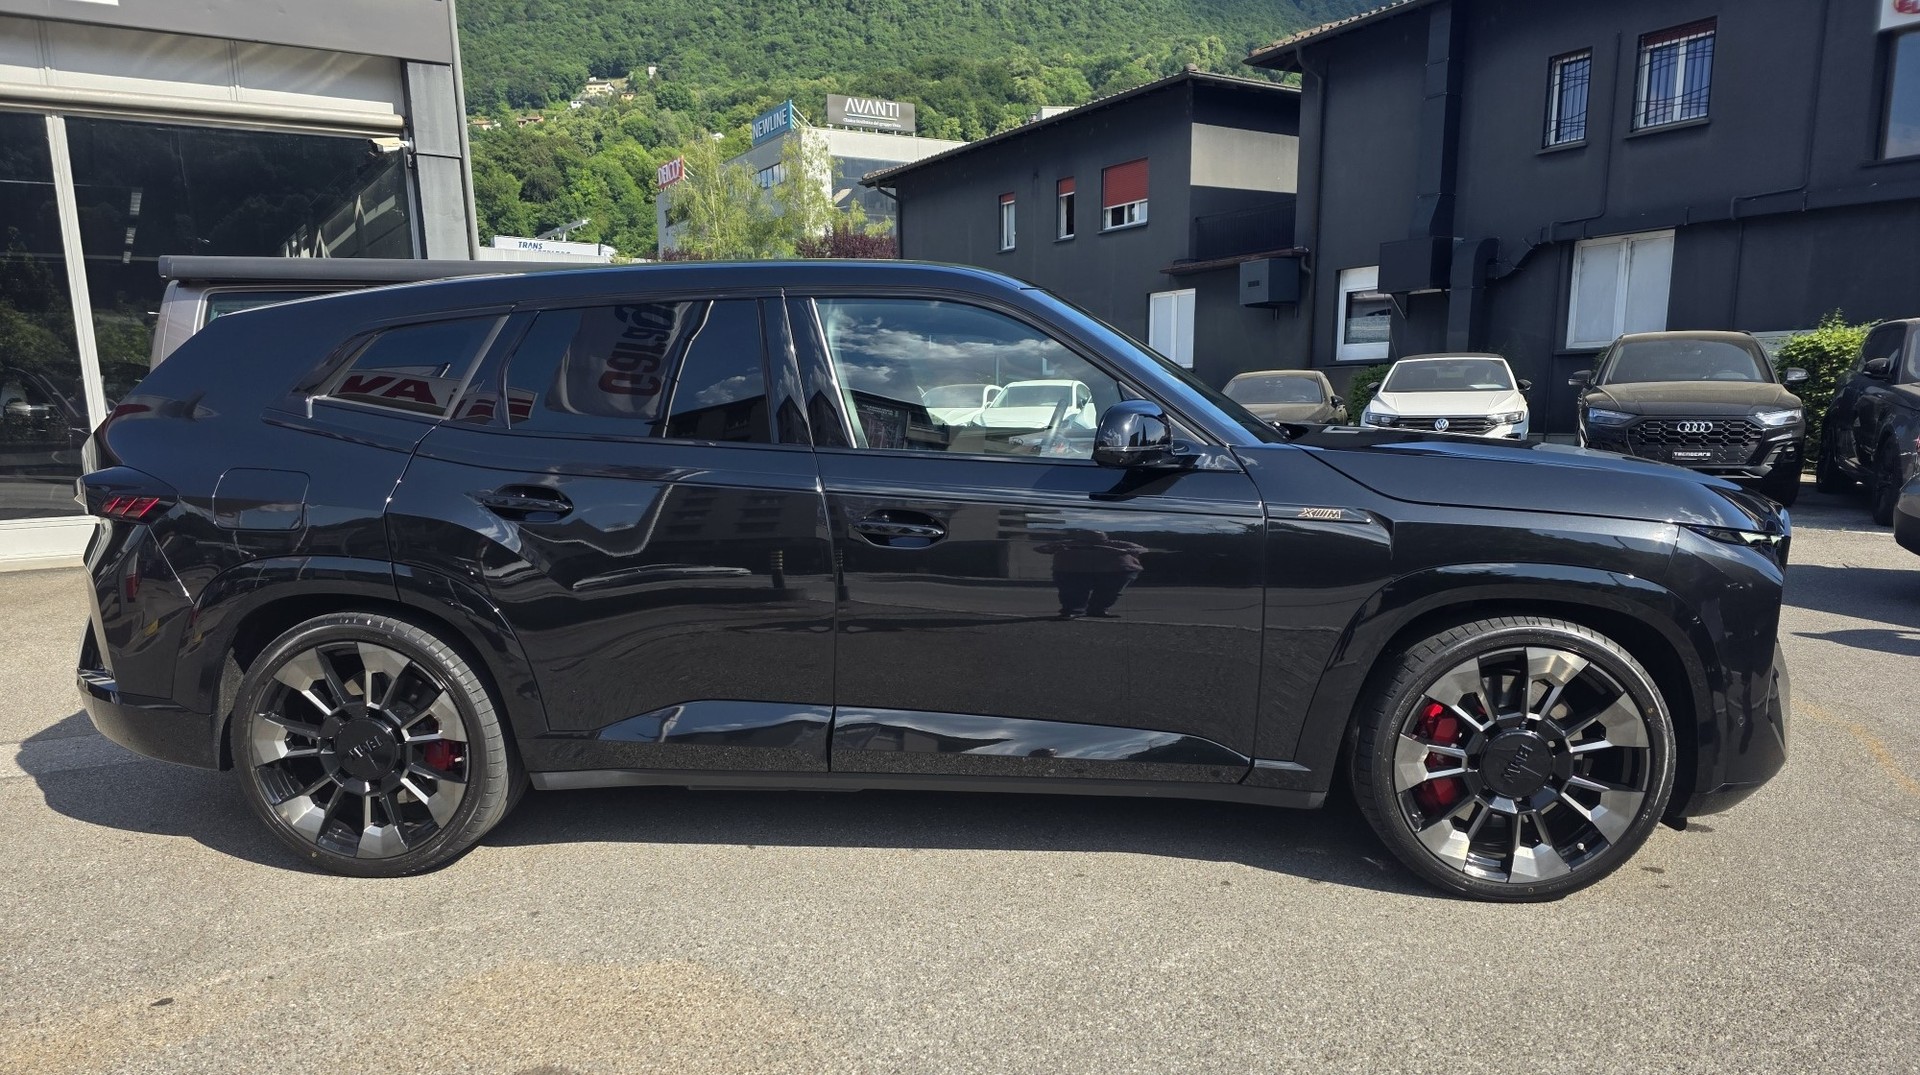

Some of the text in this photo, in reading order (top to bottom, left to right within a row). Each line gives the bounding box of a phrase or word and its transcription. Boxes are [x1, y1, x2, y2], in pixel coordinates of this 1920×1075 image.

[844, 97, 900, 117] AVANTI
[752, 107, 788, 140] NEWLINE
[518, 241, 543, 250] TRANS
